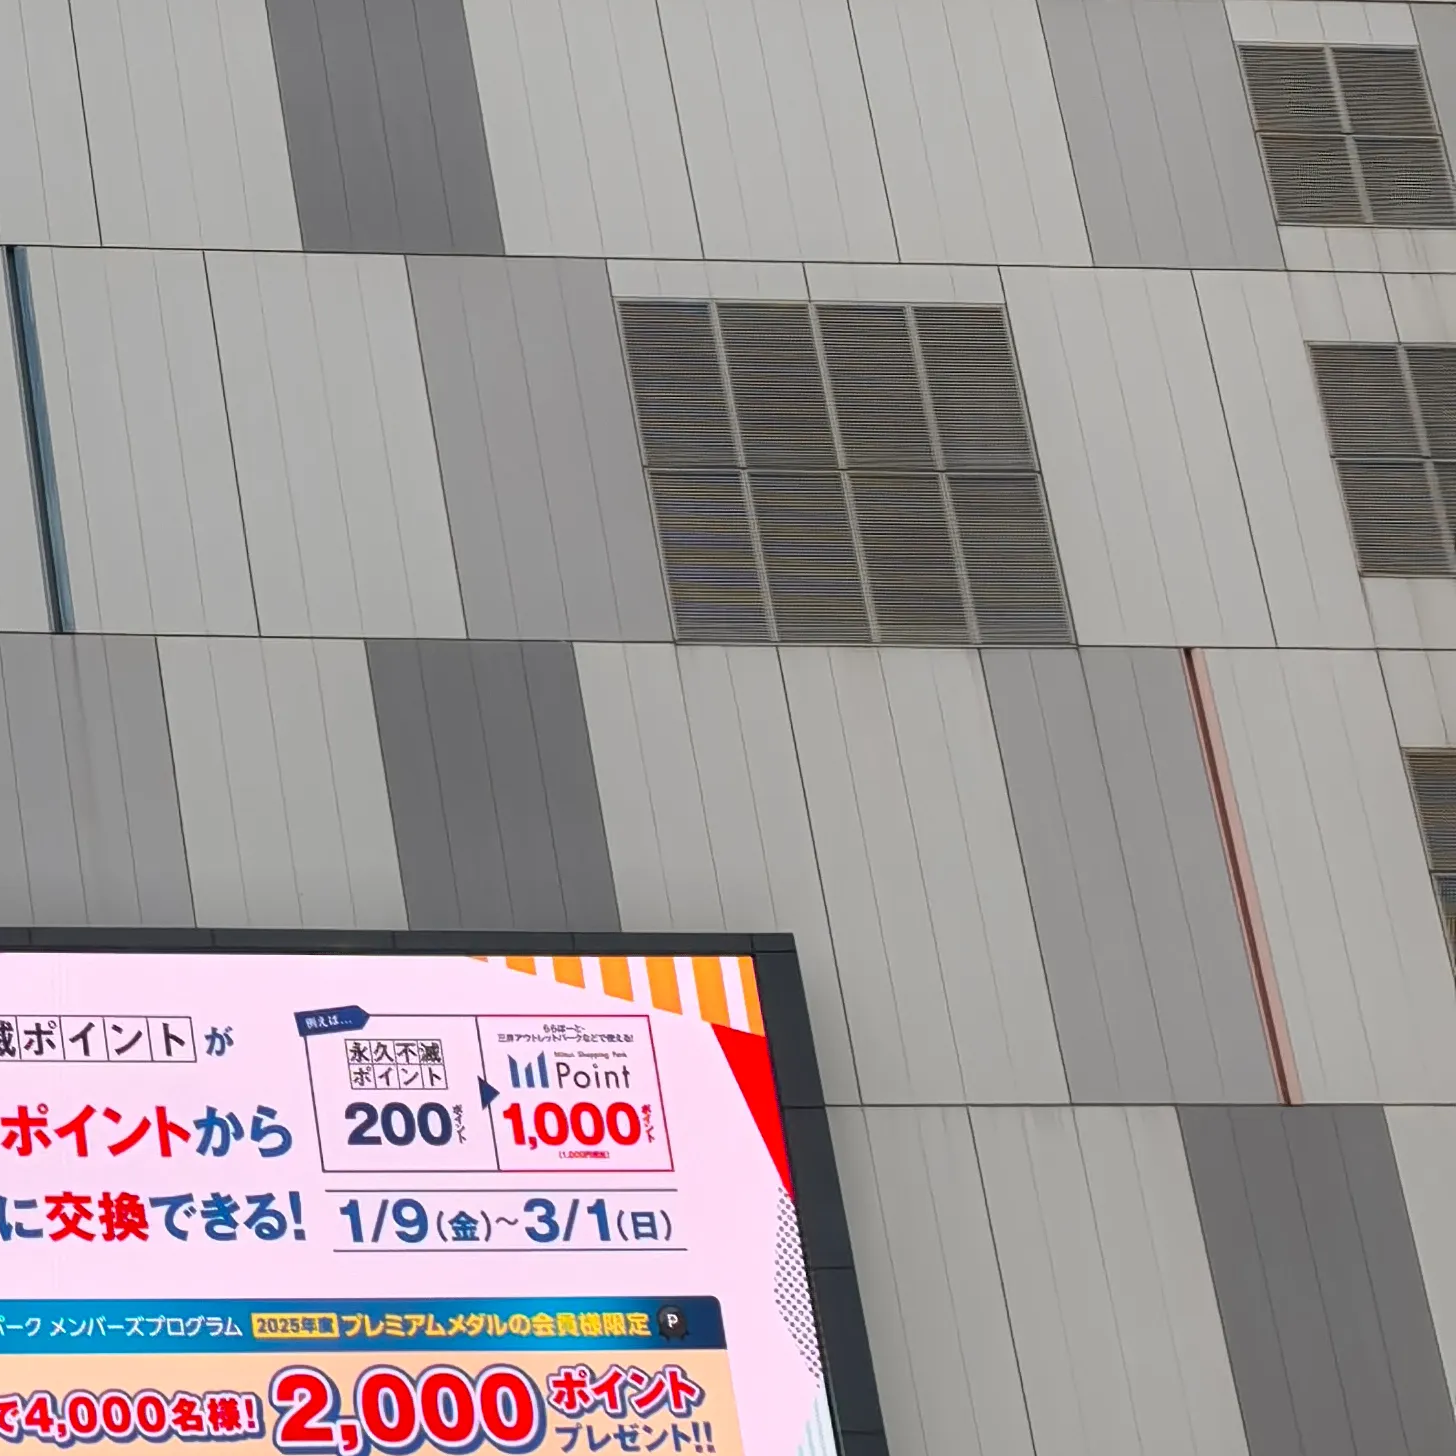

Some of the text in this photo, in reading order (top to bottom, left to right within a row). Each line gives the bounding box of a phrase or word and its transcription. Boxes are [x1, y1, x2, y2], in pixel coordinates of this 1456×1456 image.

[349, 1042, 442, 1064] 永久不滅
[353, 1064, 445, 1089] ポイント
[555, 1061, 631, 1089] Point
[344, 1101, 453, 1147] 200
[502, 1101, 642, 1150] 1,000
[49, 1316, 243, 1339] メンバーズプログラム
[343, 1311, 652, 1339] プレミアムメダルの会員様限定
[551, 1367, 700, 1413] ポイント
[274, 1370, 539, 1456] 2,000
[554, 1421, 716, 1454] プレゼント!!
